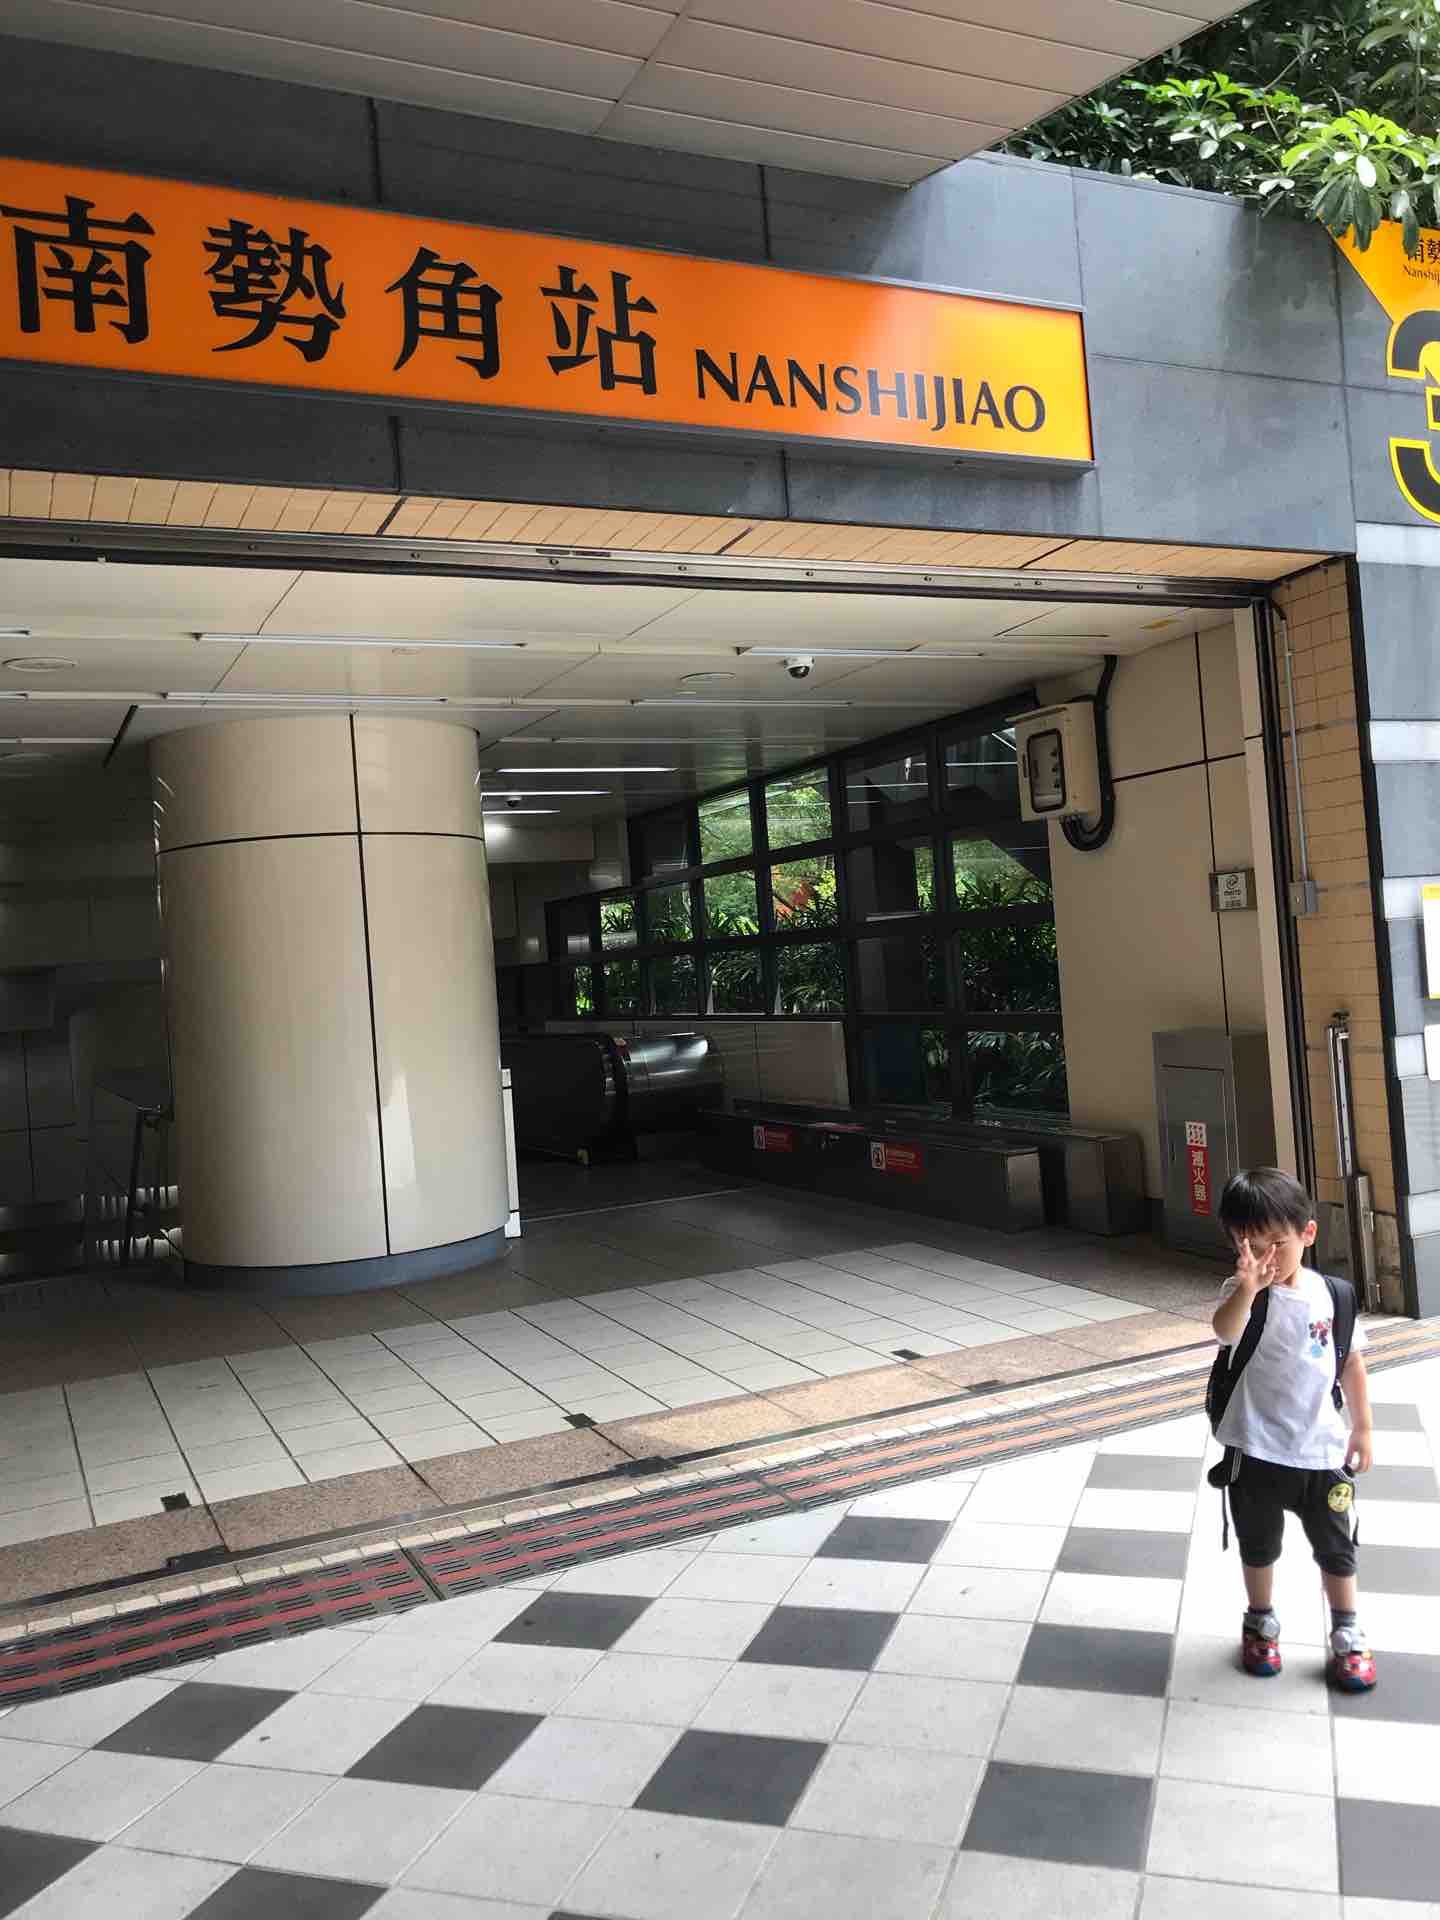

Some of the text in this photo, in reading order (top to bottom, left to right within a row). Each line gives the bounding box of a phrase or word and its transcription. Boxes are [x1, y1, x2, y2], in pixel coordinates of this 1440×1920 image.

[1, 194, 658, 396] 南勢角站
[695, 348, 1047, 433] NANSHIJIAO
